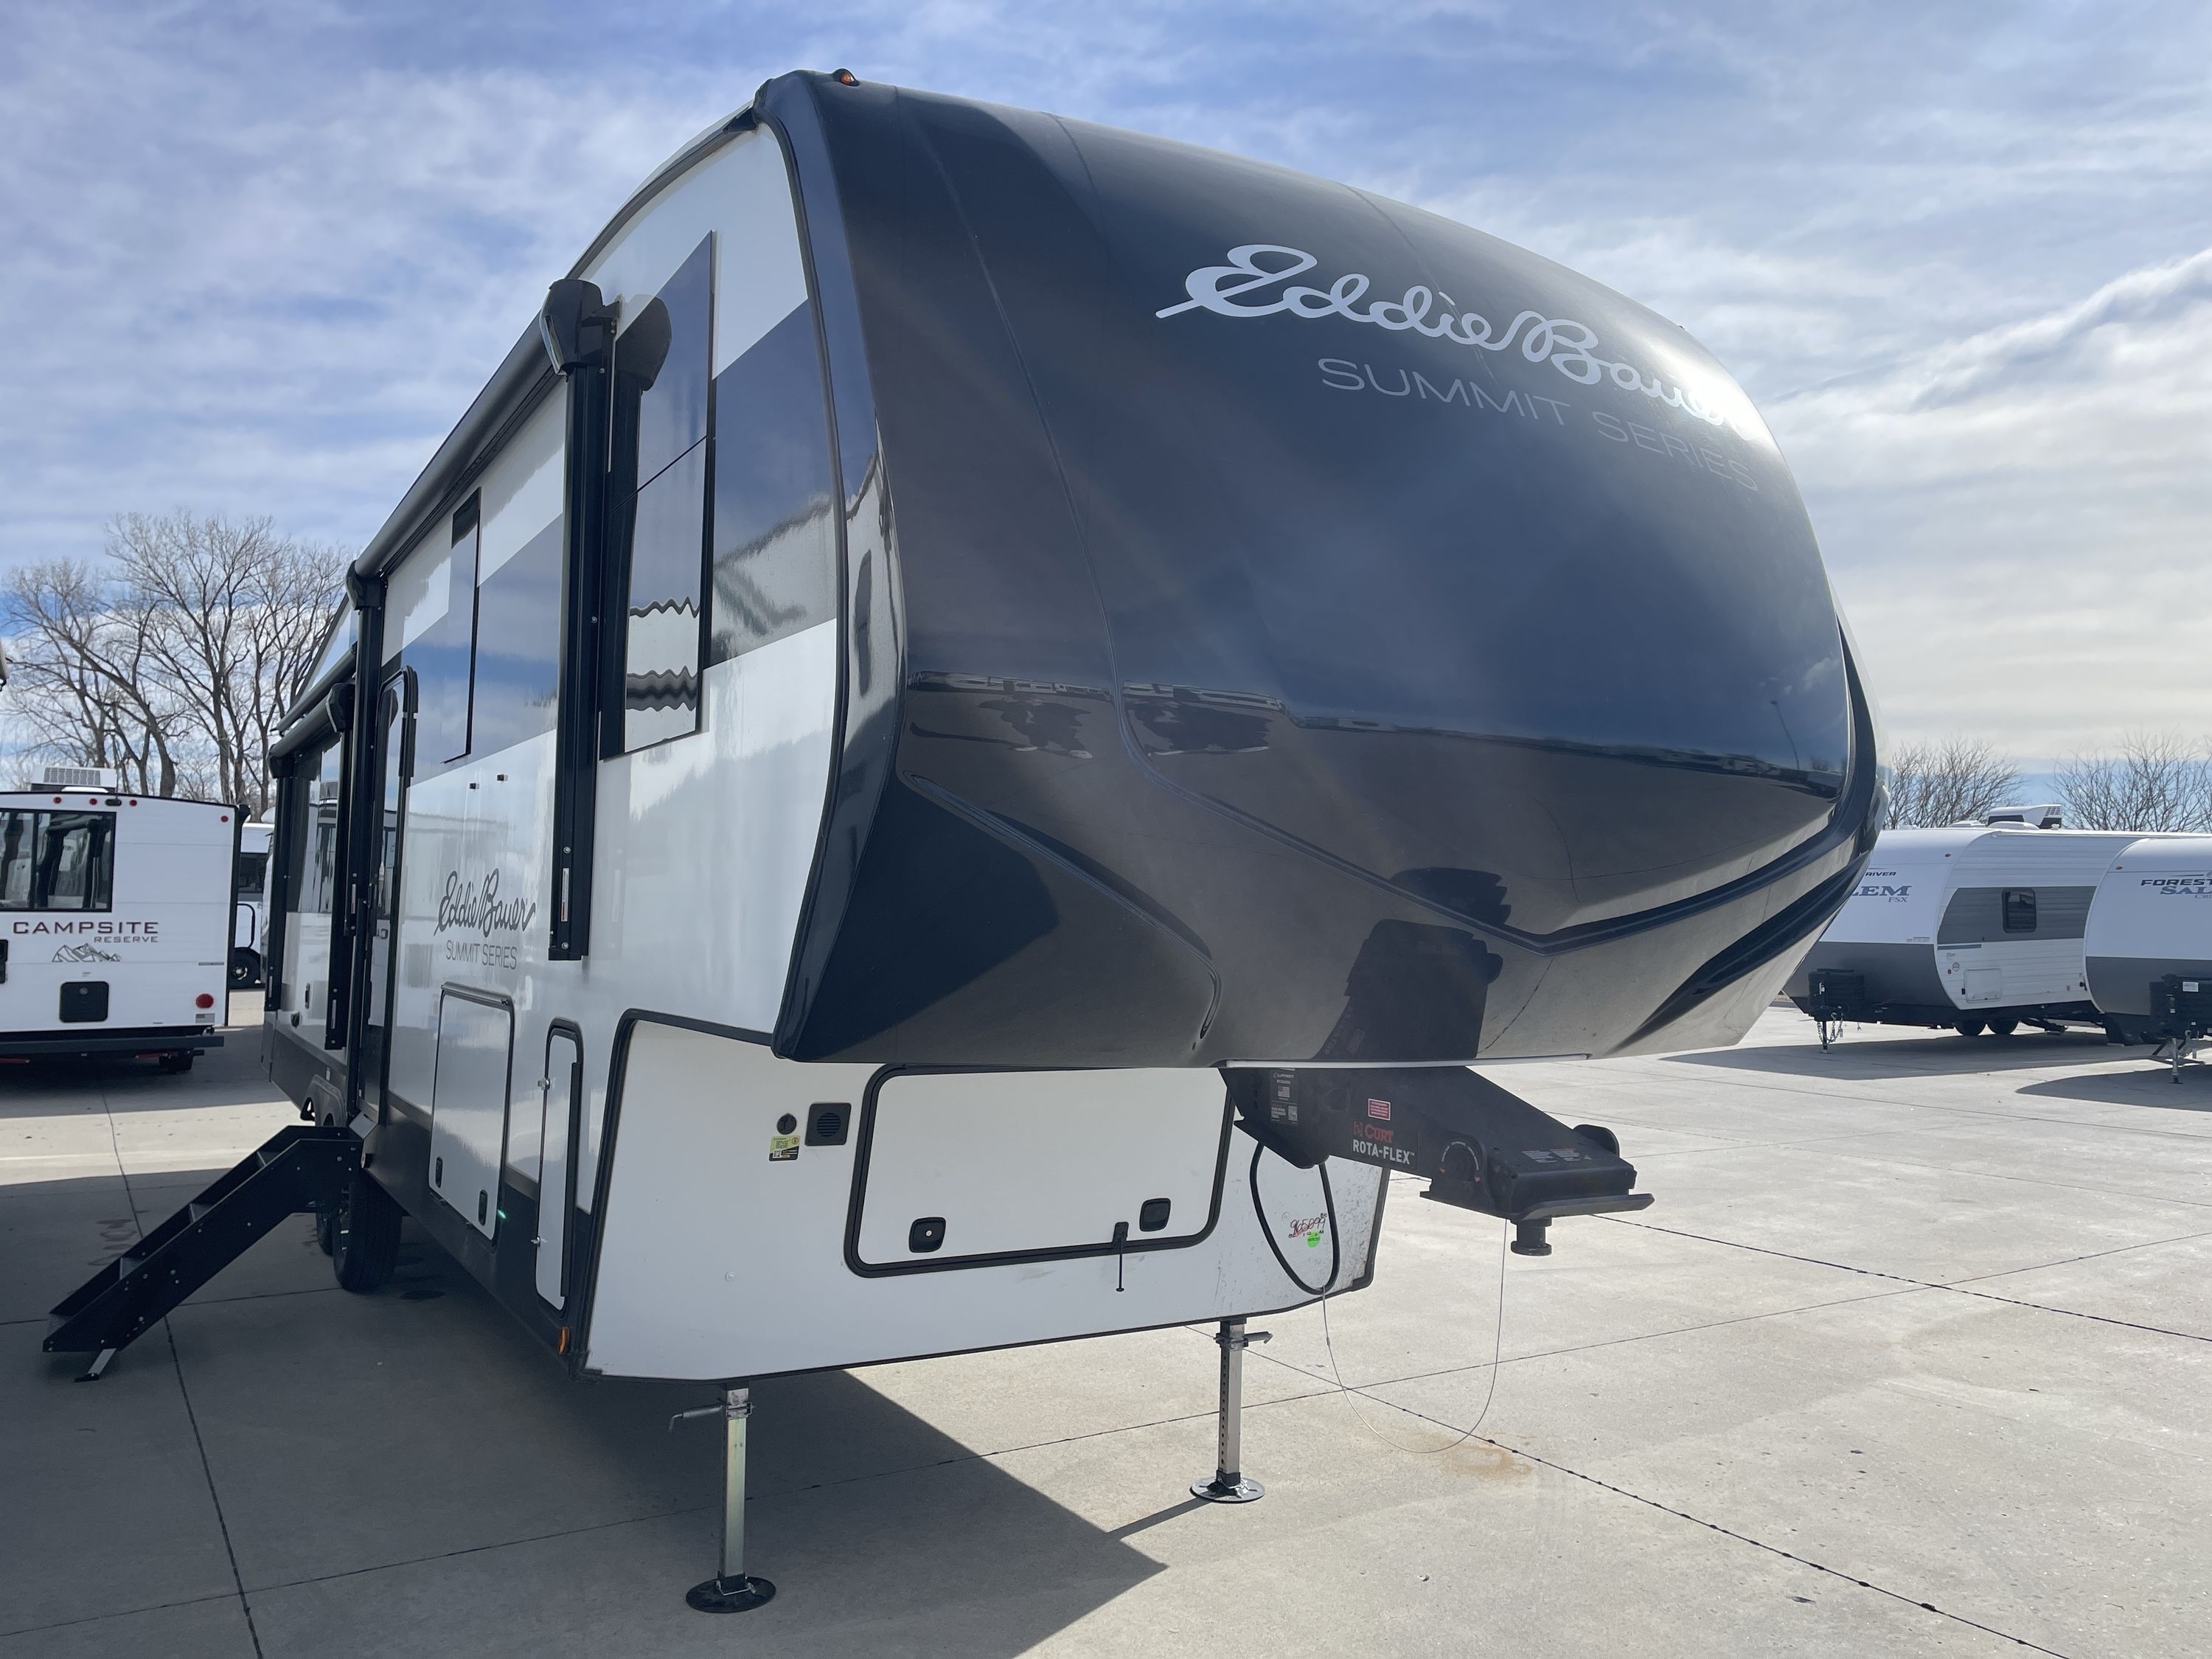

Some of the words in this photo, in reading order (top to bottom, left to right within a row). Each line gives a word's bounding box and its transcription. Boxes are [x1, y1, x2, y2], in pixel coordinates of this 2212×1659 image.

[1155, 244, 1497, 349] Eddie
[1501, 310, 1765, 442] Baue
[1318, 358, 1571, 425] SUMMIT
[1592, 411, 1759, 492] SERIES
[434, 870, 478, 936] Eddie
[479, 868, 536, 939] Bauer
[1851, 886, 1912, 897] EM
[13, 922, 159, 934] CAMPSITE
[445, 939, 481, 964] SUMMIT
[481, 943, 518, 970] SERIES
[1364, 1123, 1394, 1144] CURT
